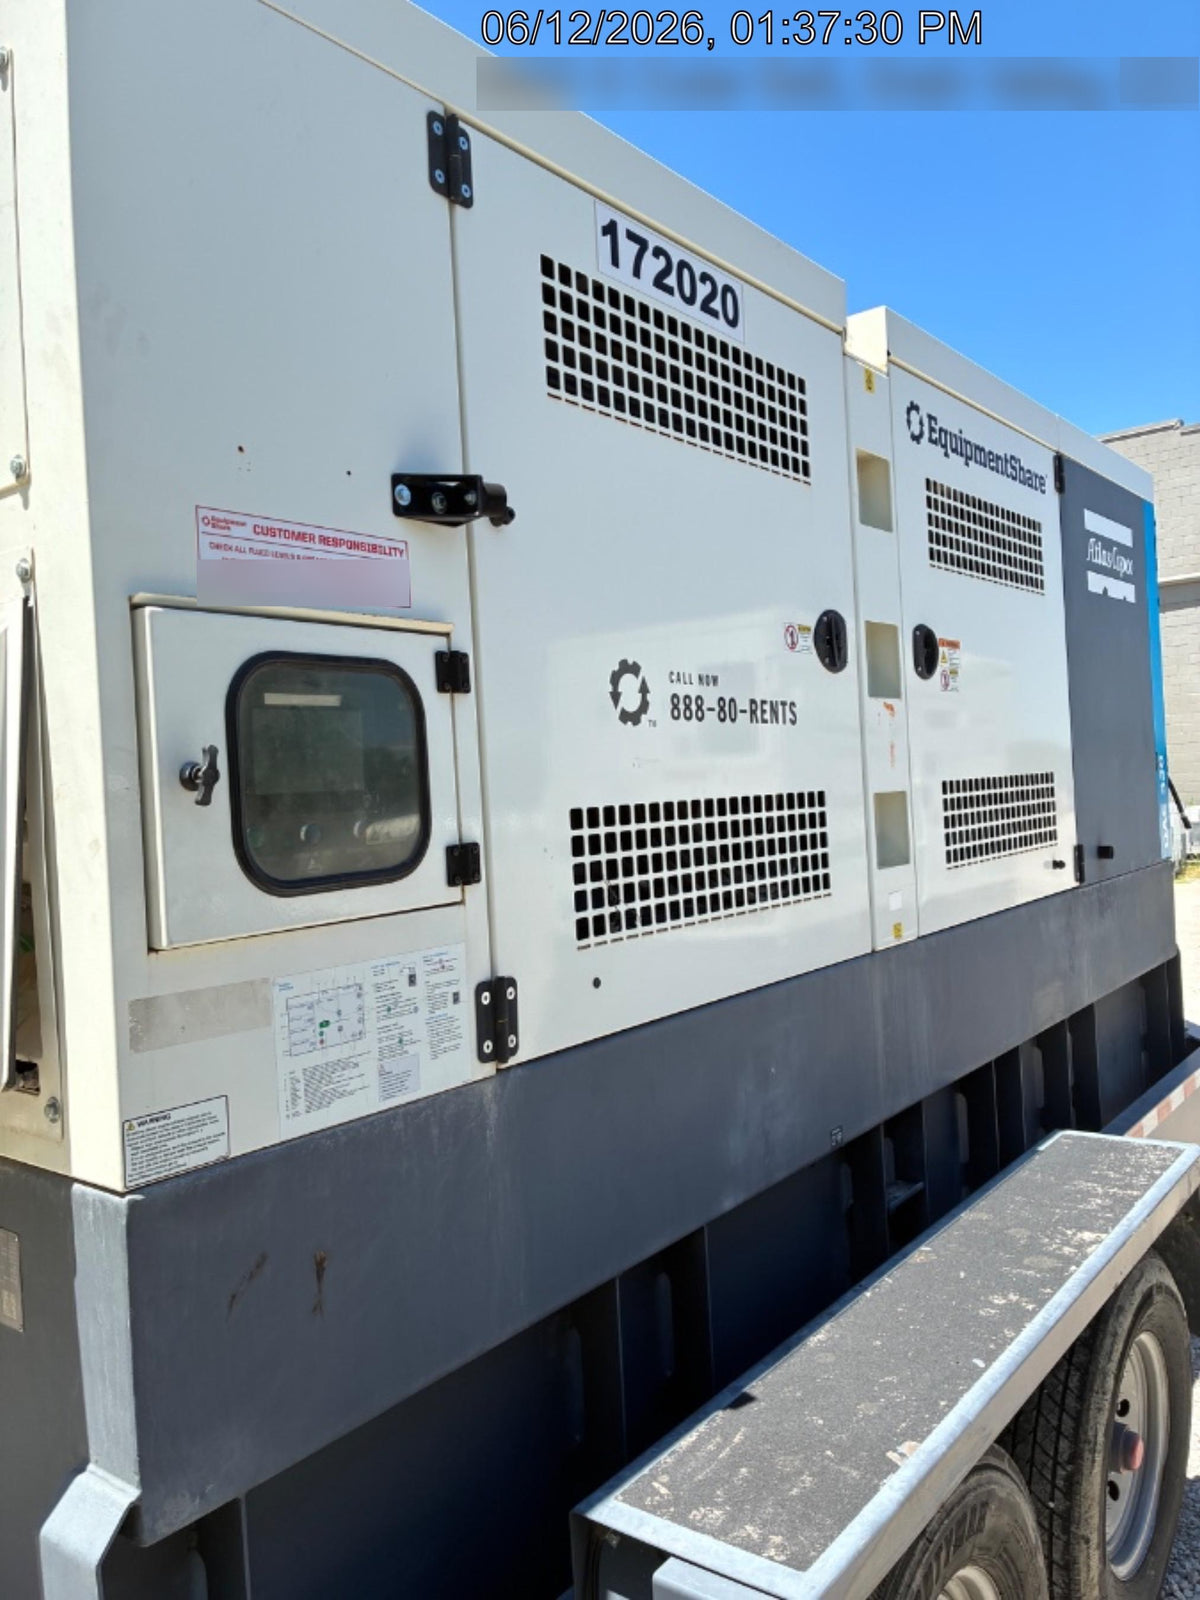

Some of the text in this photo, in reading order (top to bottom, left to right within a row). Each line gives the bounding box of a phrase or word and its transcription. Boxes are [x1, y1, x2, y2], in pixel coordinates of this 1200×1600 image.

[601, 218, 739, 329] 172020
[926, 412, 1047, 495] EquipmentShare
[233, 545, 247, 555] ALL
[253, 523, 405, 557] CUSTOMER RESPONSIBILITY
[668, 670, 720, 687] CALL NOW
[669, 692, 798, 727] 888-80-RENTS
